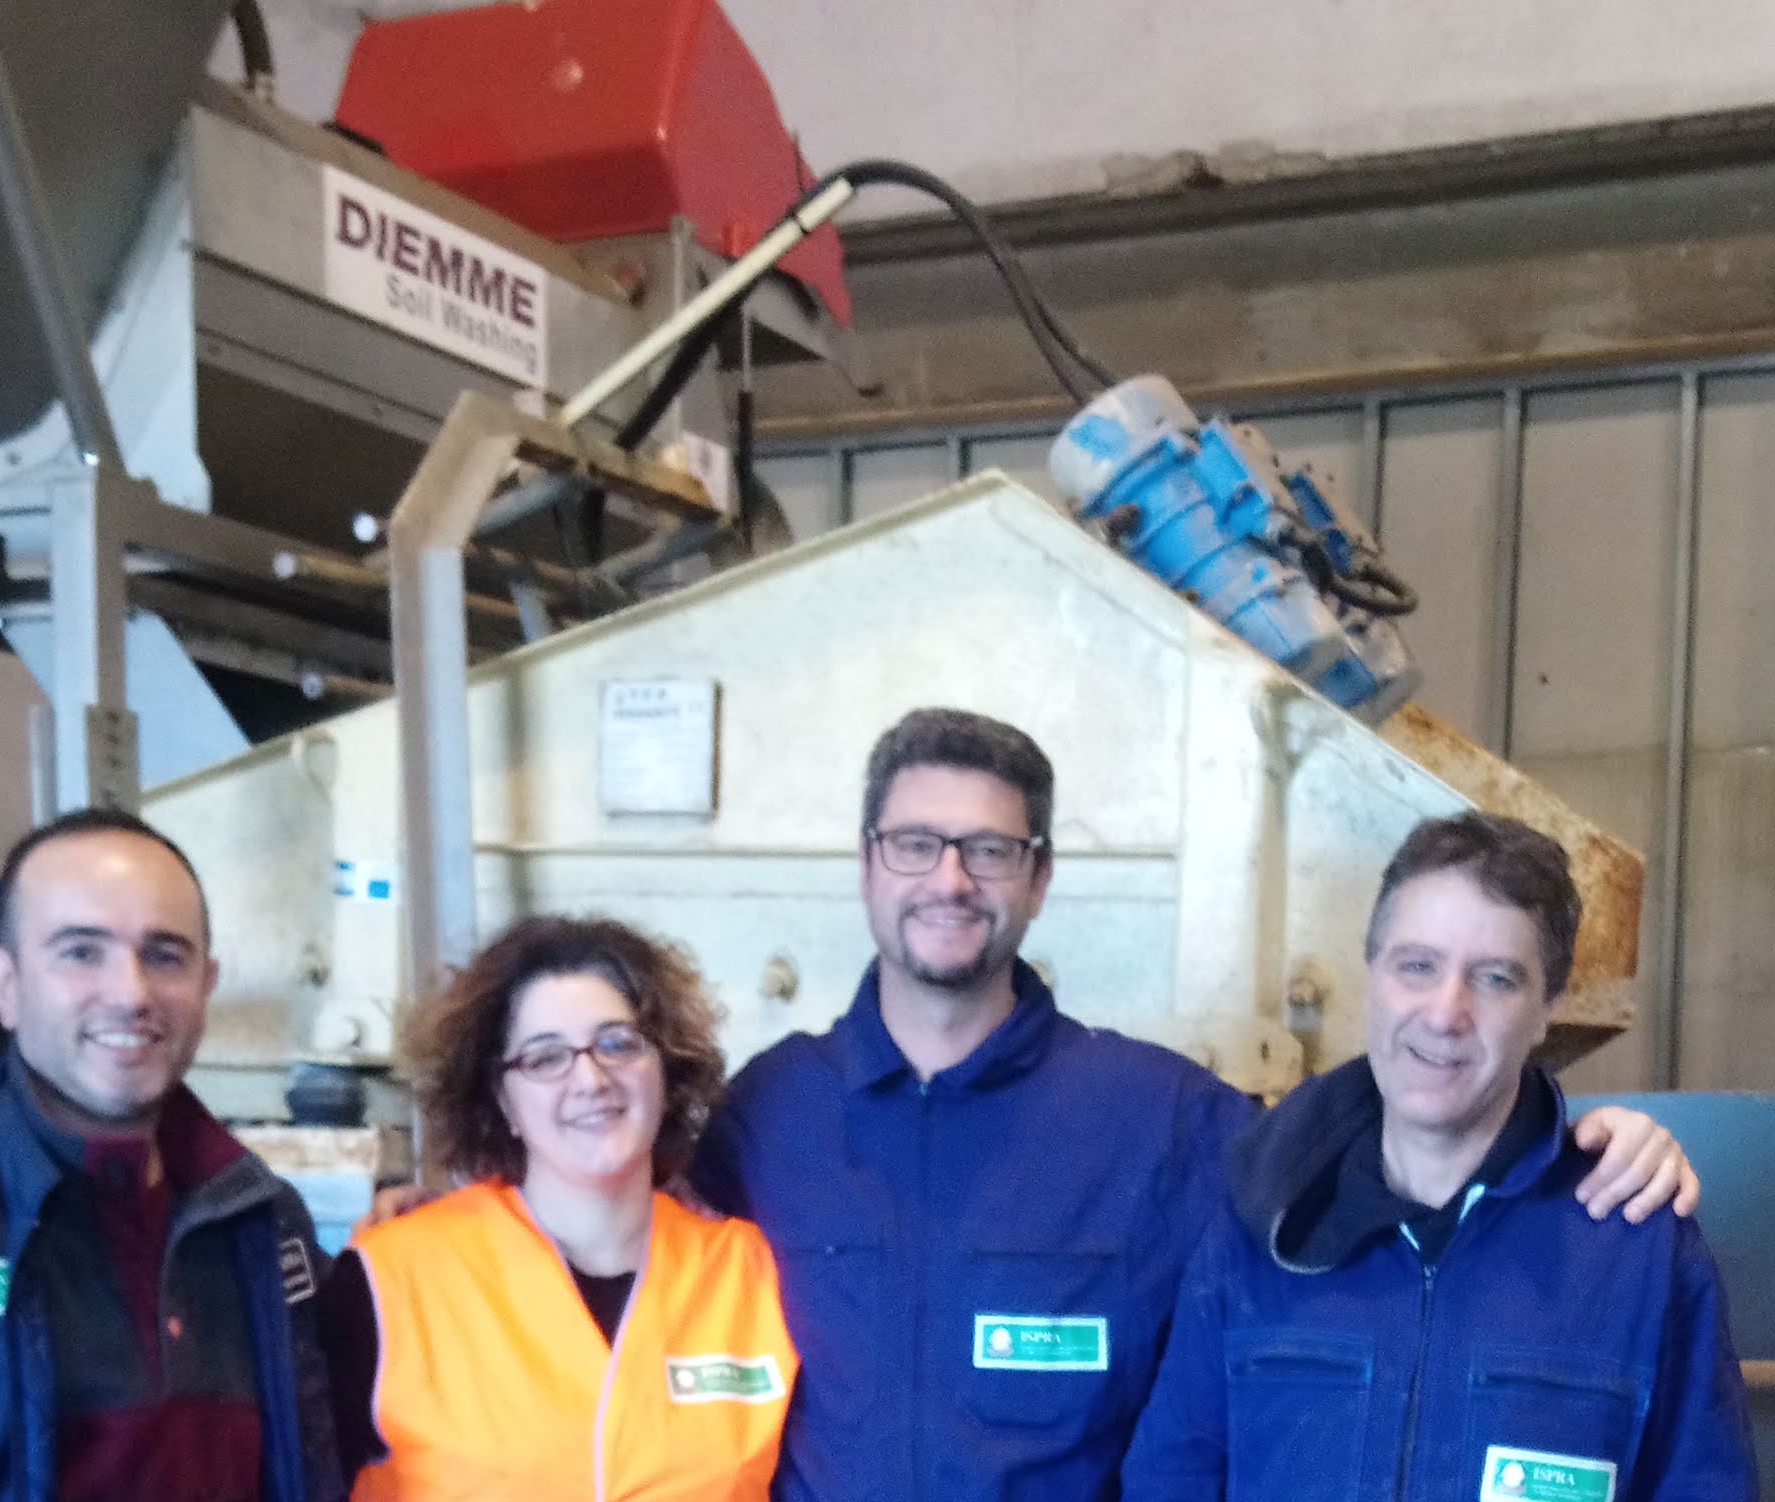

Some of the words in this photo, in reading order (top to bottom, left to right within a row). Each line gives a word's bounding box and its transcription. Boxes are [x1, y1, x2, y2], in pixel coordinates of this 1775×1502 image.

[336, 194, 536, 328] DIEMME
[385, 274, 433, 322] Soil
[441, 299, 538, 376] Washing
[1532, 1465, 1576, 1486] ISPRA
